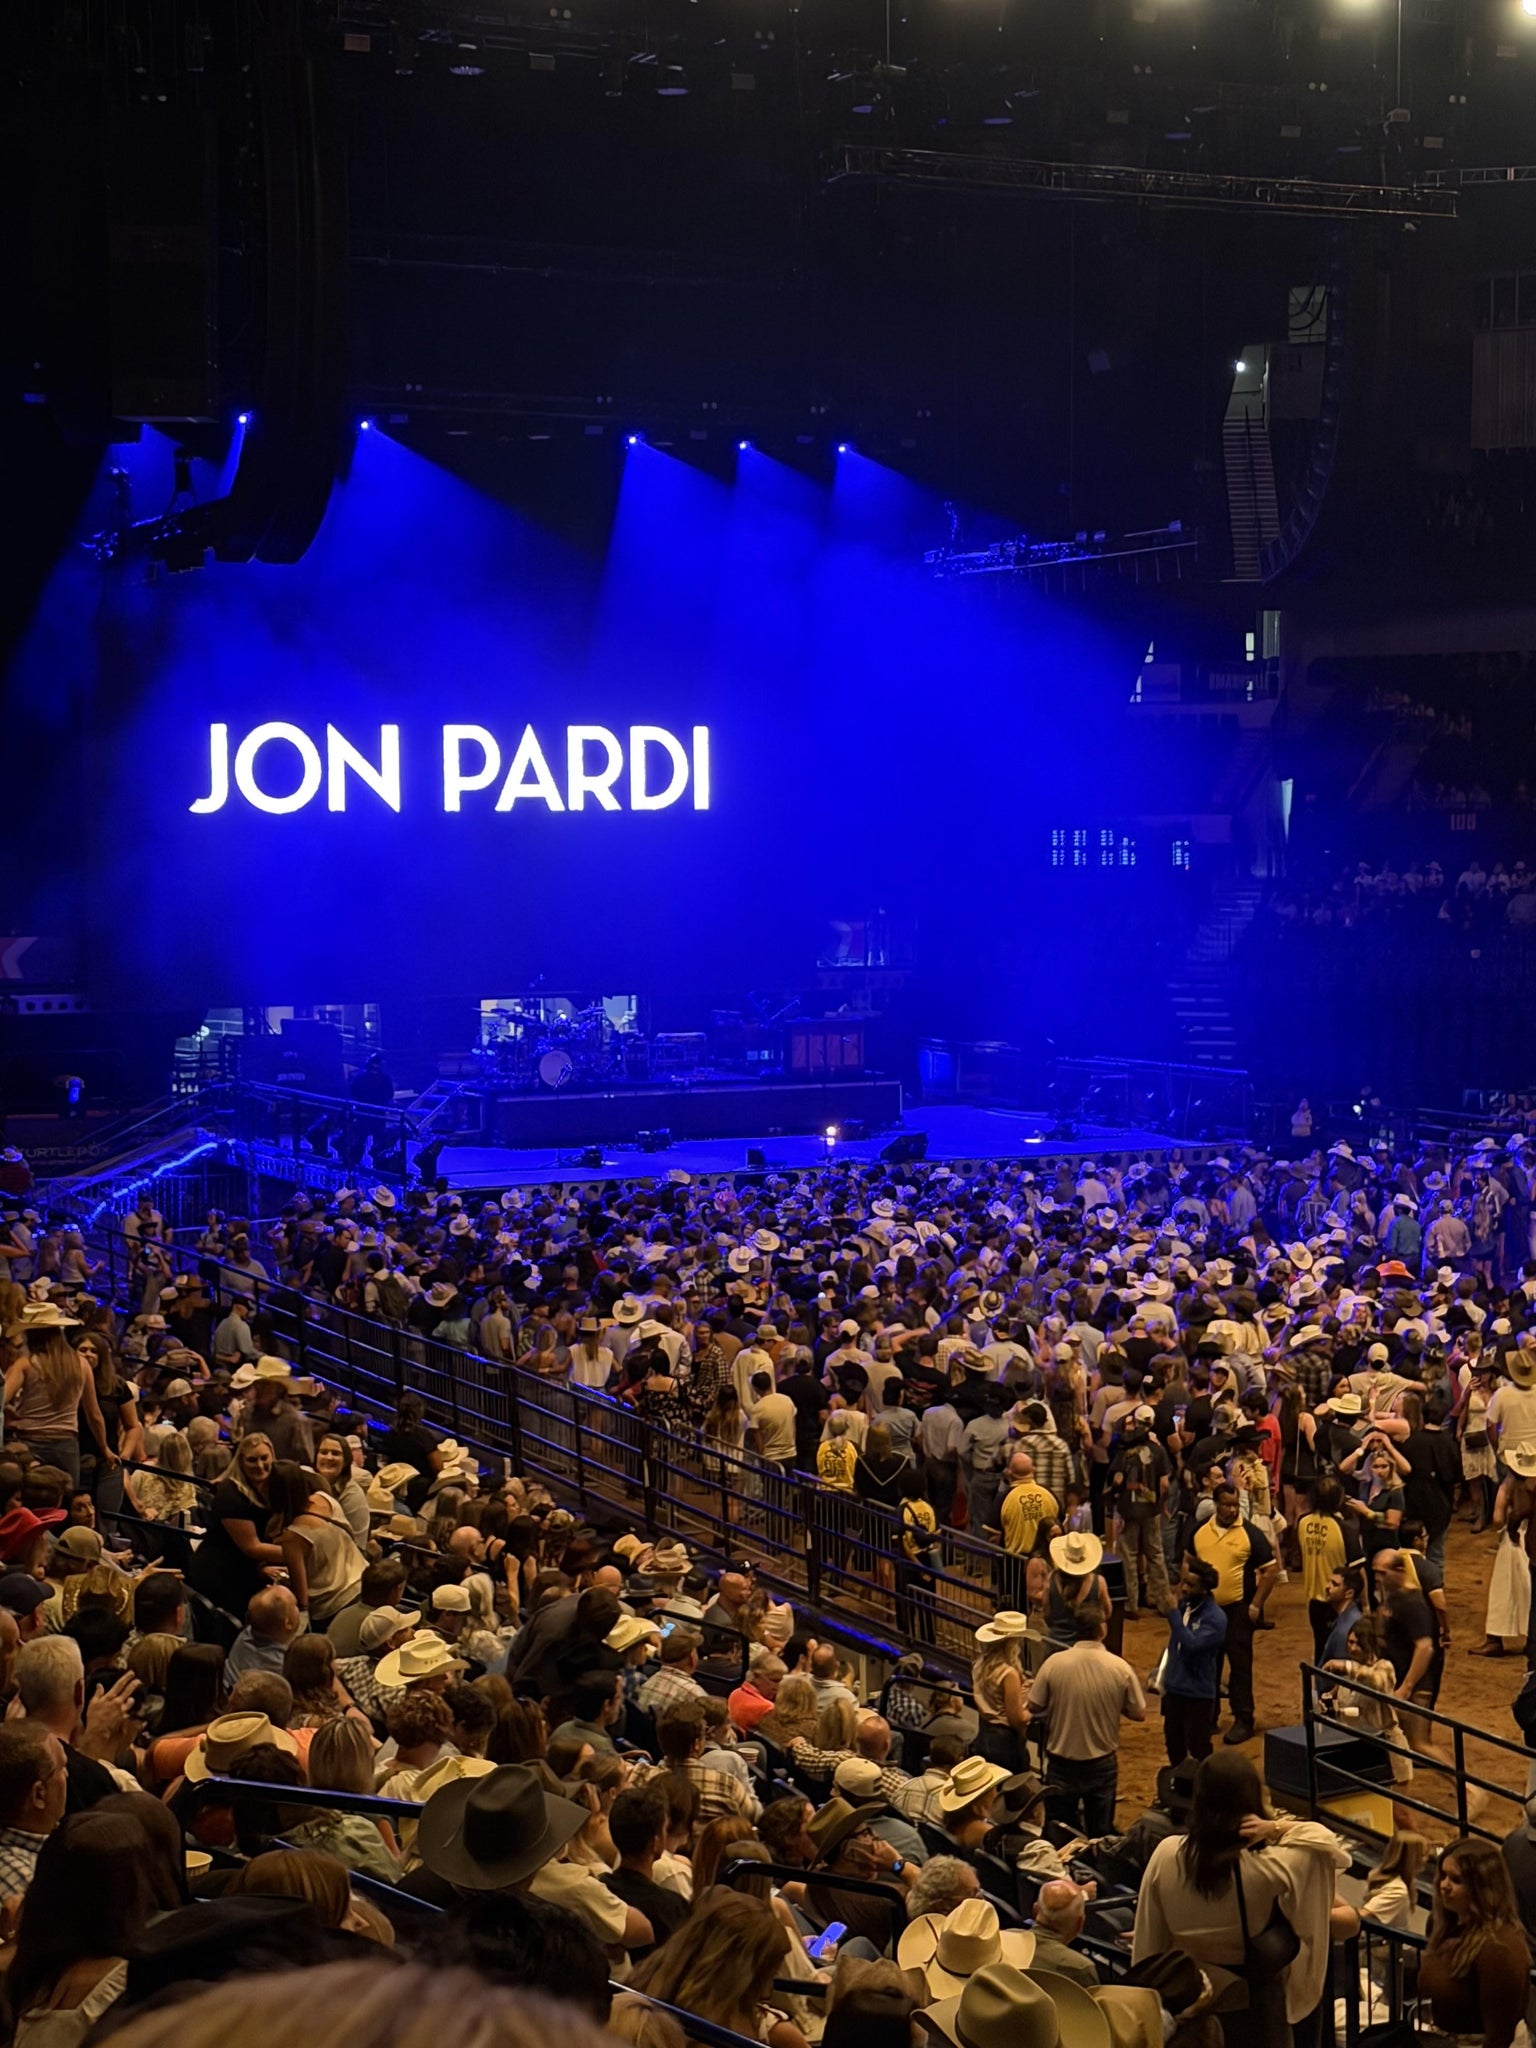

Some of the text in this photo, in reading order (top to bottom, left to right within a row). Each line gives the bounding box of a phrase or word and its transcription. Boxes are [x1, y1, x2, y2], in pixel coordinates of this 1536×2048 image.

[188, 722, 710, 815] JON PARDI
[1019, 1493, 1042, 1504] CSC
